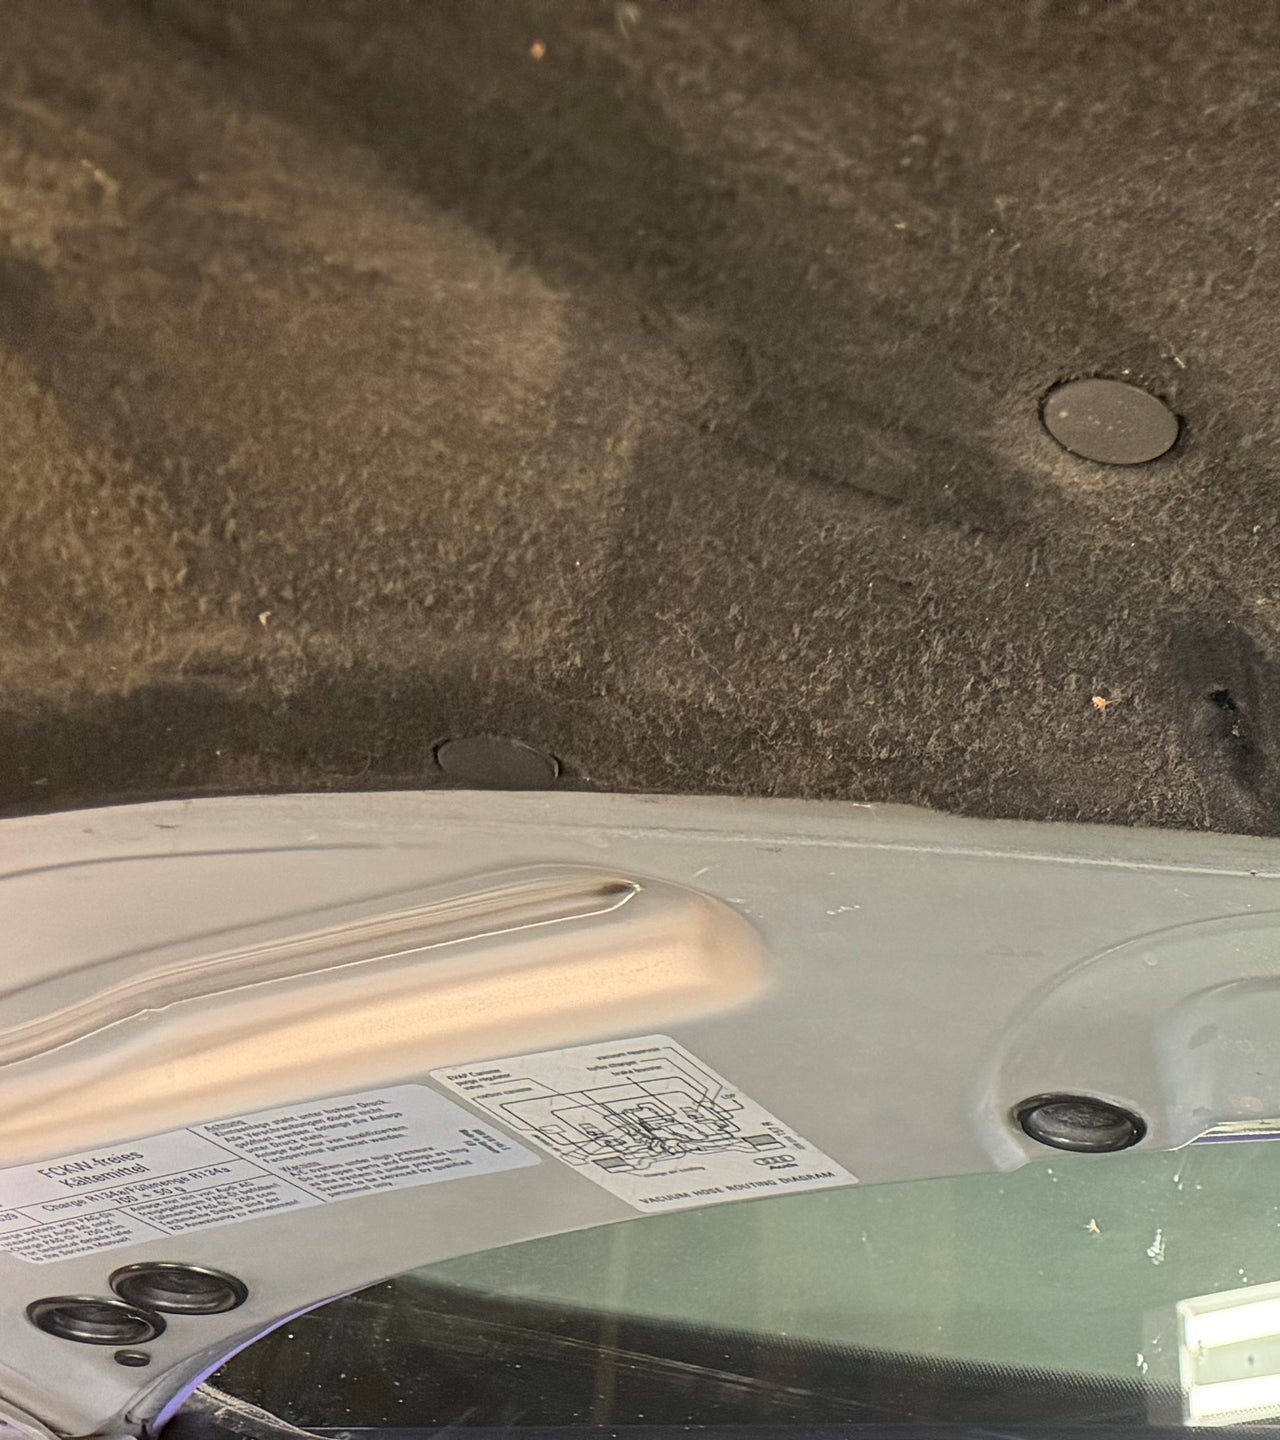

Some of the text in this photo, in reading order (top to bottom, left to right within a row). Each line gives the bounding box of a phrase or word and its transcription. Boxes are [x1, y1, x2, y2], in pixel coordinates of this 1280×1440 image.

[37, 1150, 145, 1180] FCKW-freies
[58, 1162, 151, 1190] Kältemittel
[639, 1192, 692, 1204] VACUUM
[725, 1178, 778, 1192] ROUTING
[778, 1171, 836, 1185] DIAGRAM
